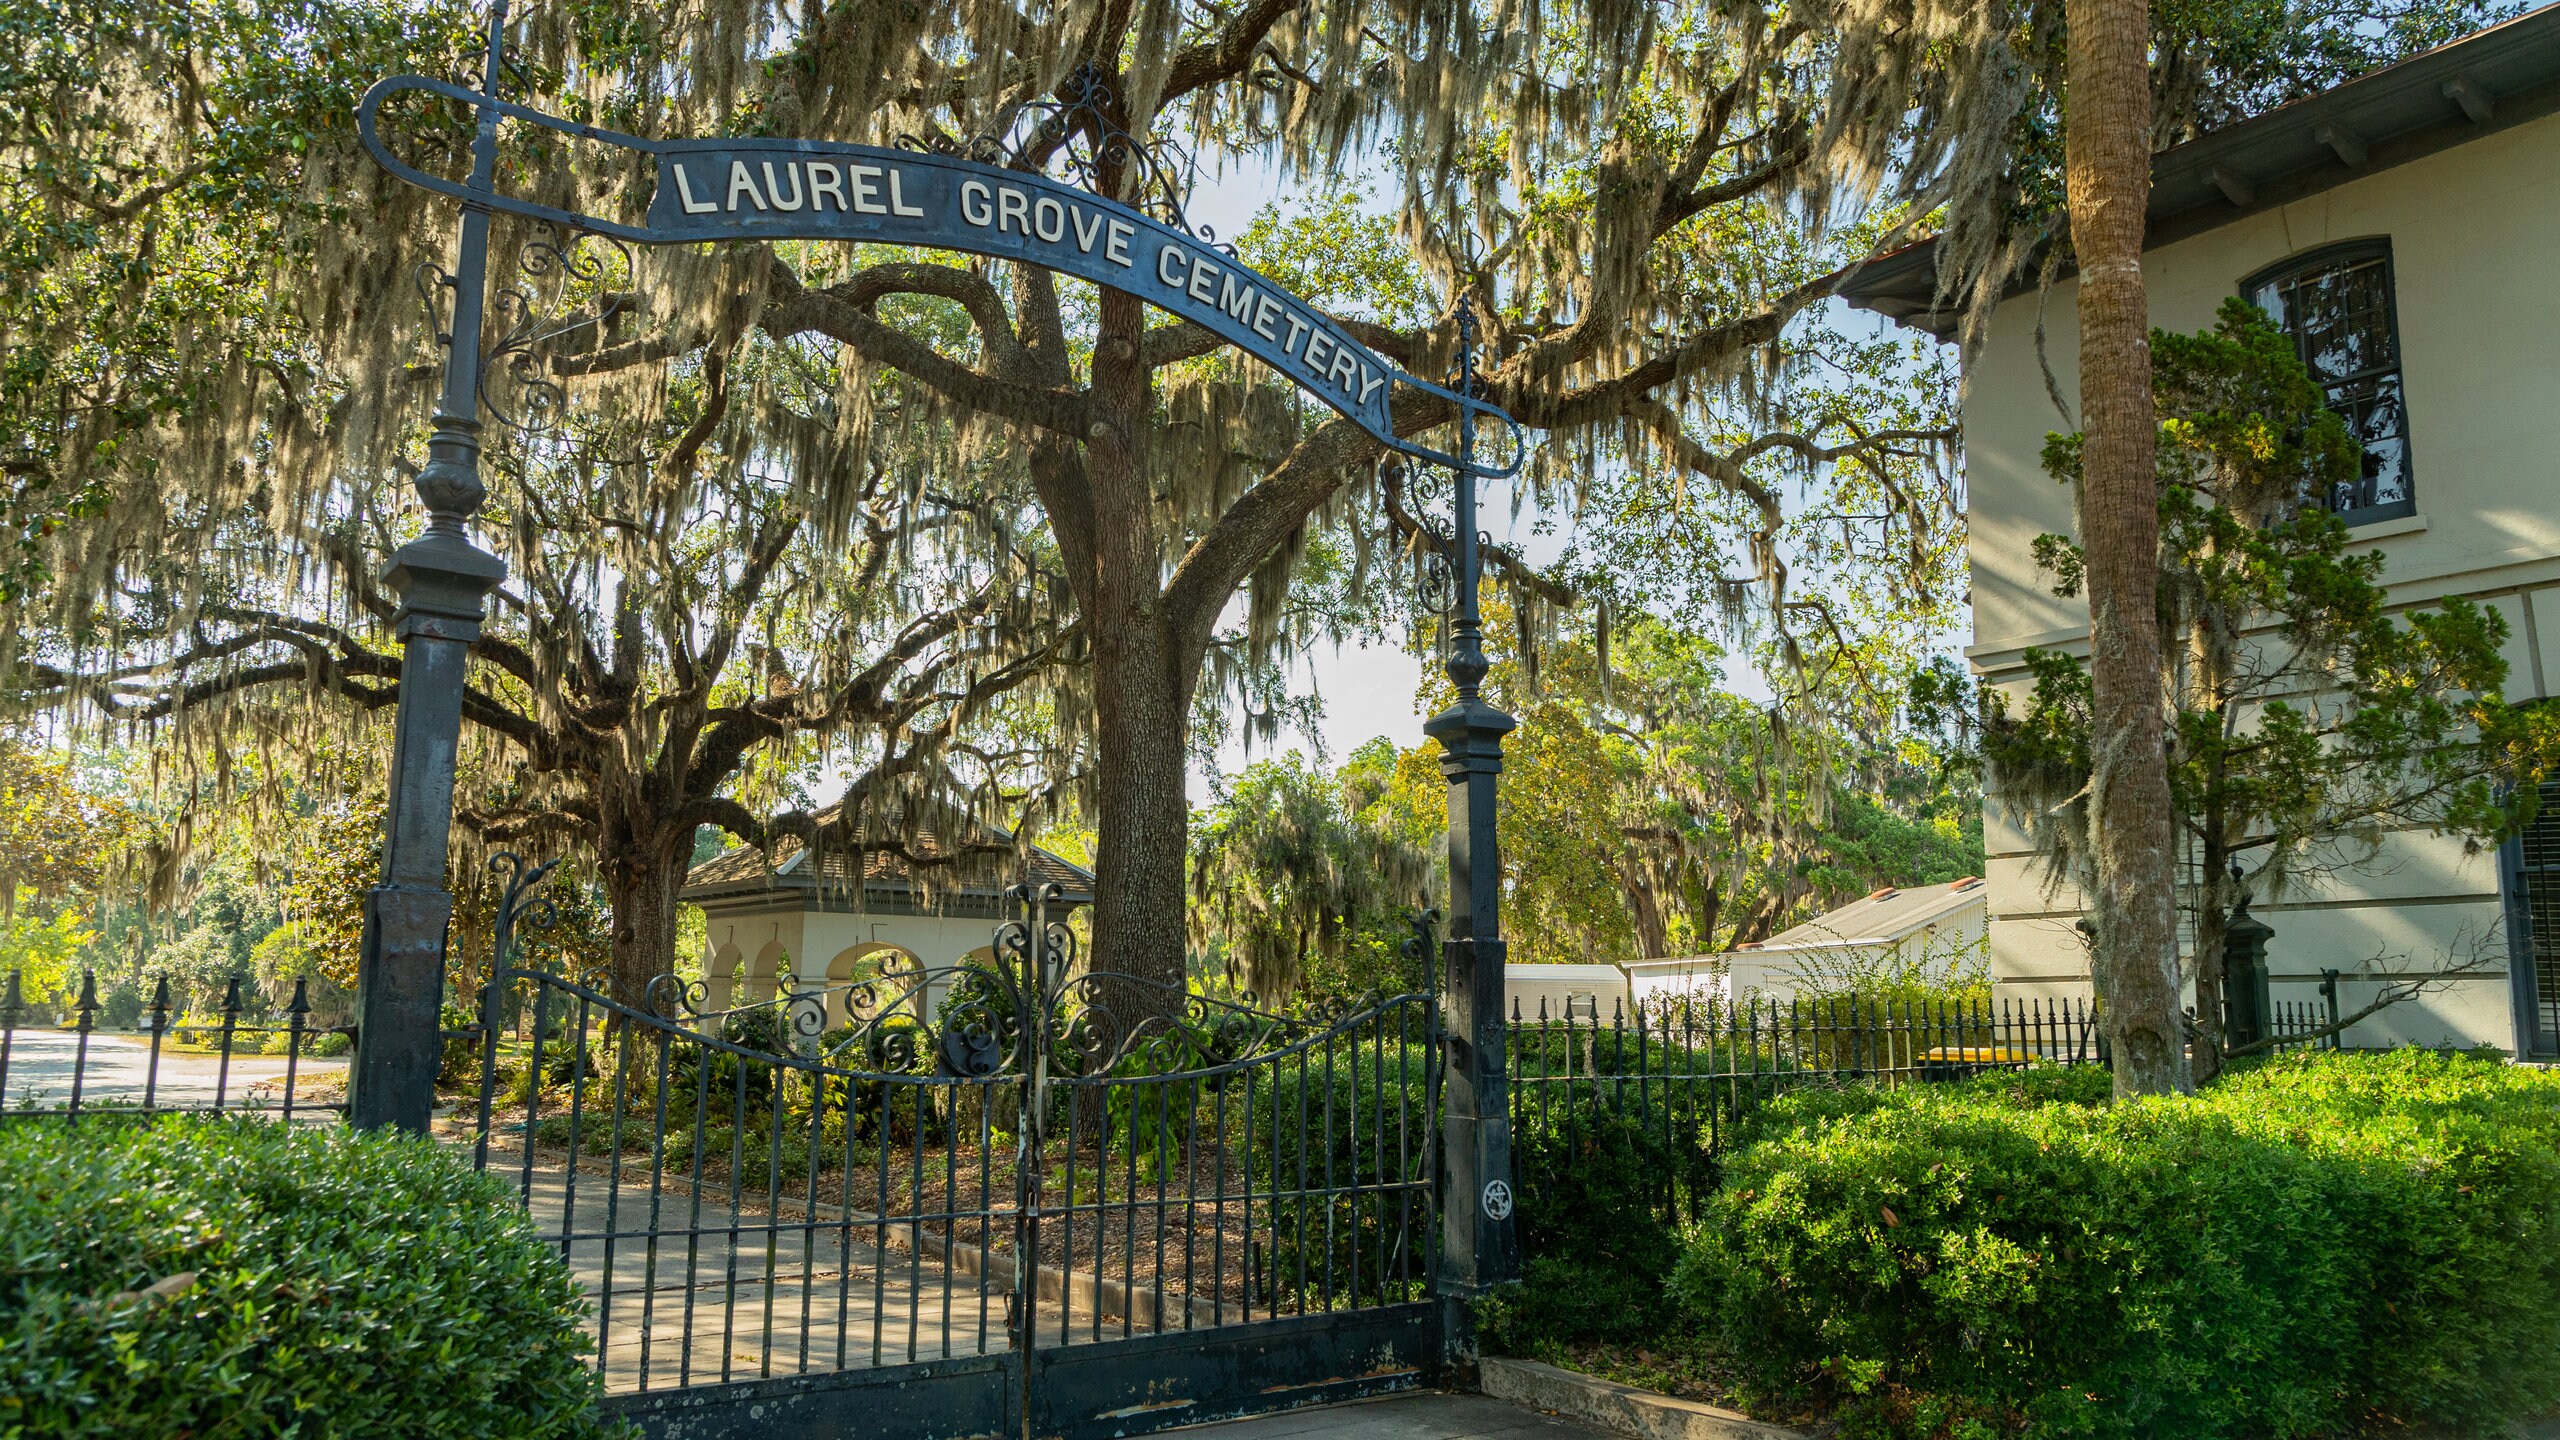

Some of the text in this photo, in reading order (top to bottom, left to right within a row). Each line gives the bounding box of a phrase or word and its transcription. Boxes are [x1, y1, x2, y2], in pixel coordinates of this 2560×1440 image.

[673, 160, 1385, 405] LAUREL GROVE CEMETERY
